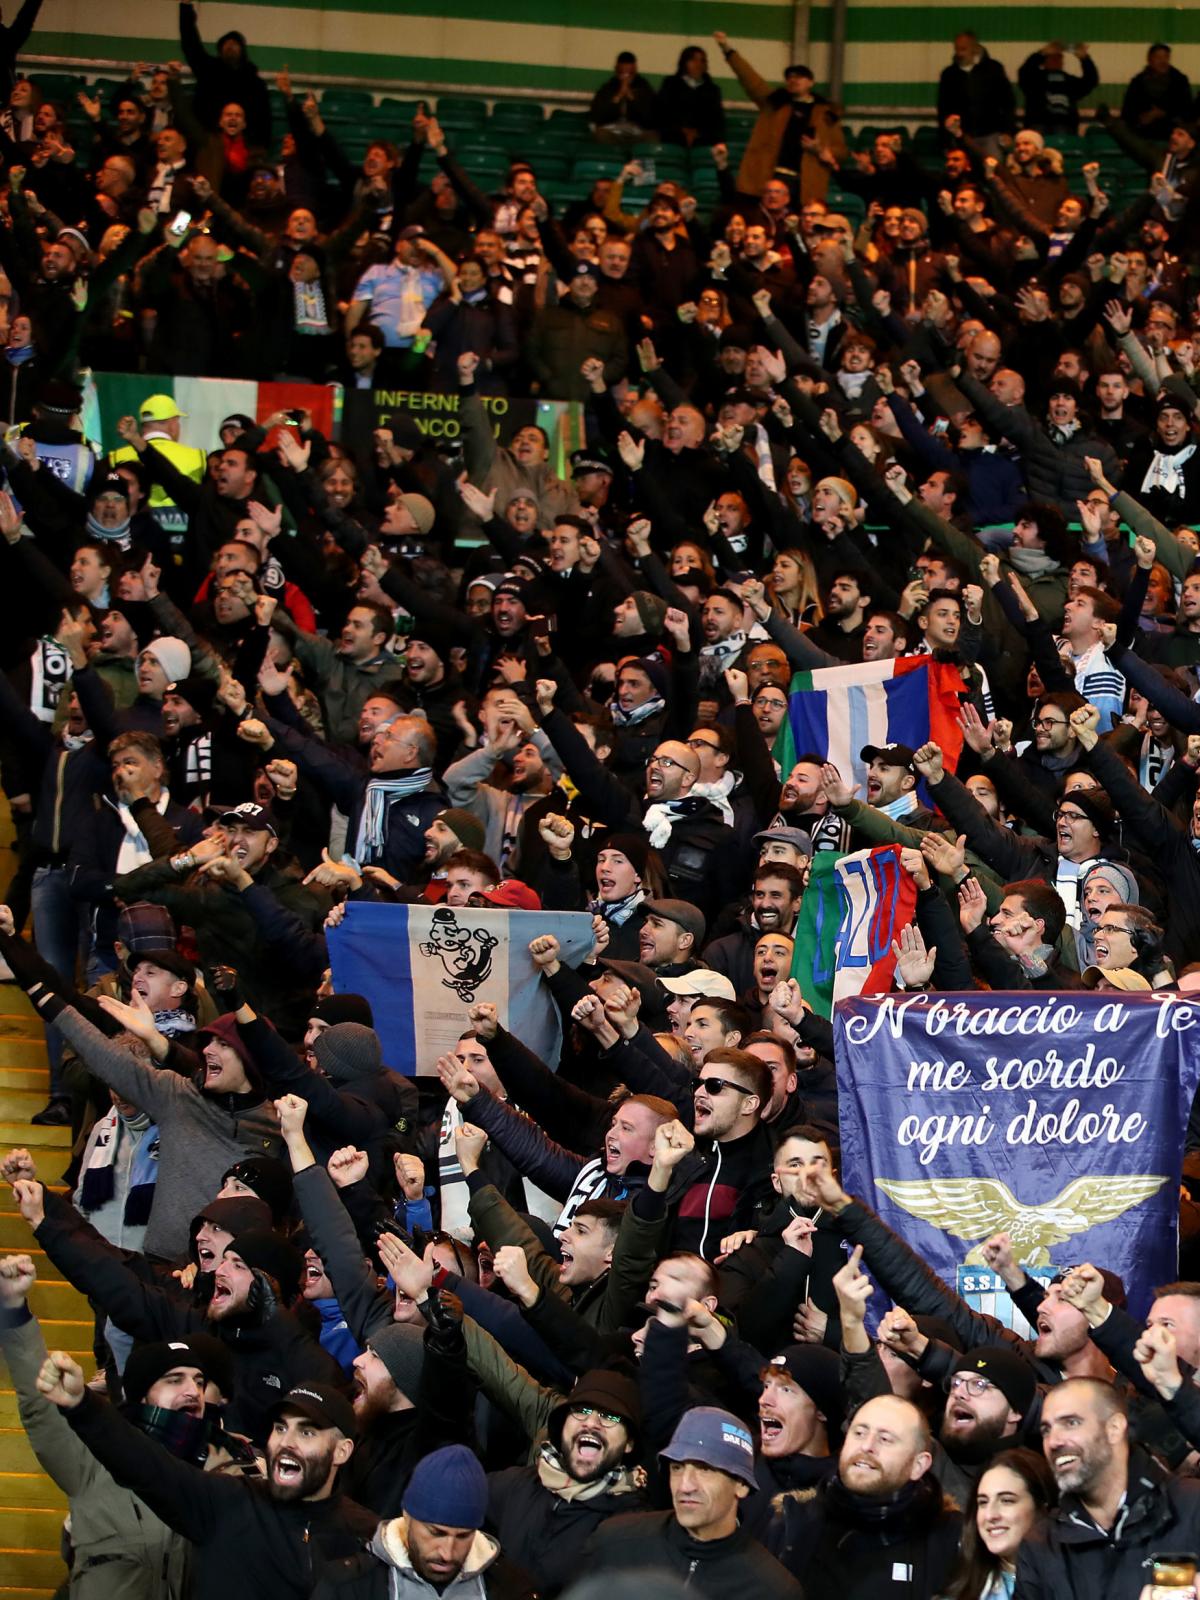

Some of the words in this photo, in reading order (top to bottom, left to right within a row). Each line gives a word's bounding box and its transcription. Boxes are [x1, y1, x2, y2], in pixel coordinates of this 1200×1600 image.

[374, 389, 508, 415] INFERNETO
[925, 997, 1082, 1036] braccio
[1093, 1002, 1130, 1033] a
[907, 1060, 971, 1092] me
[981, 1043, 1125, 1092] scordo
[897, 1105, 995, 1165] ogni
[1005, 1098, 1147, 1146] dolore
